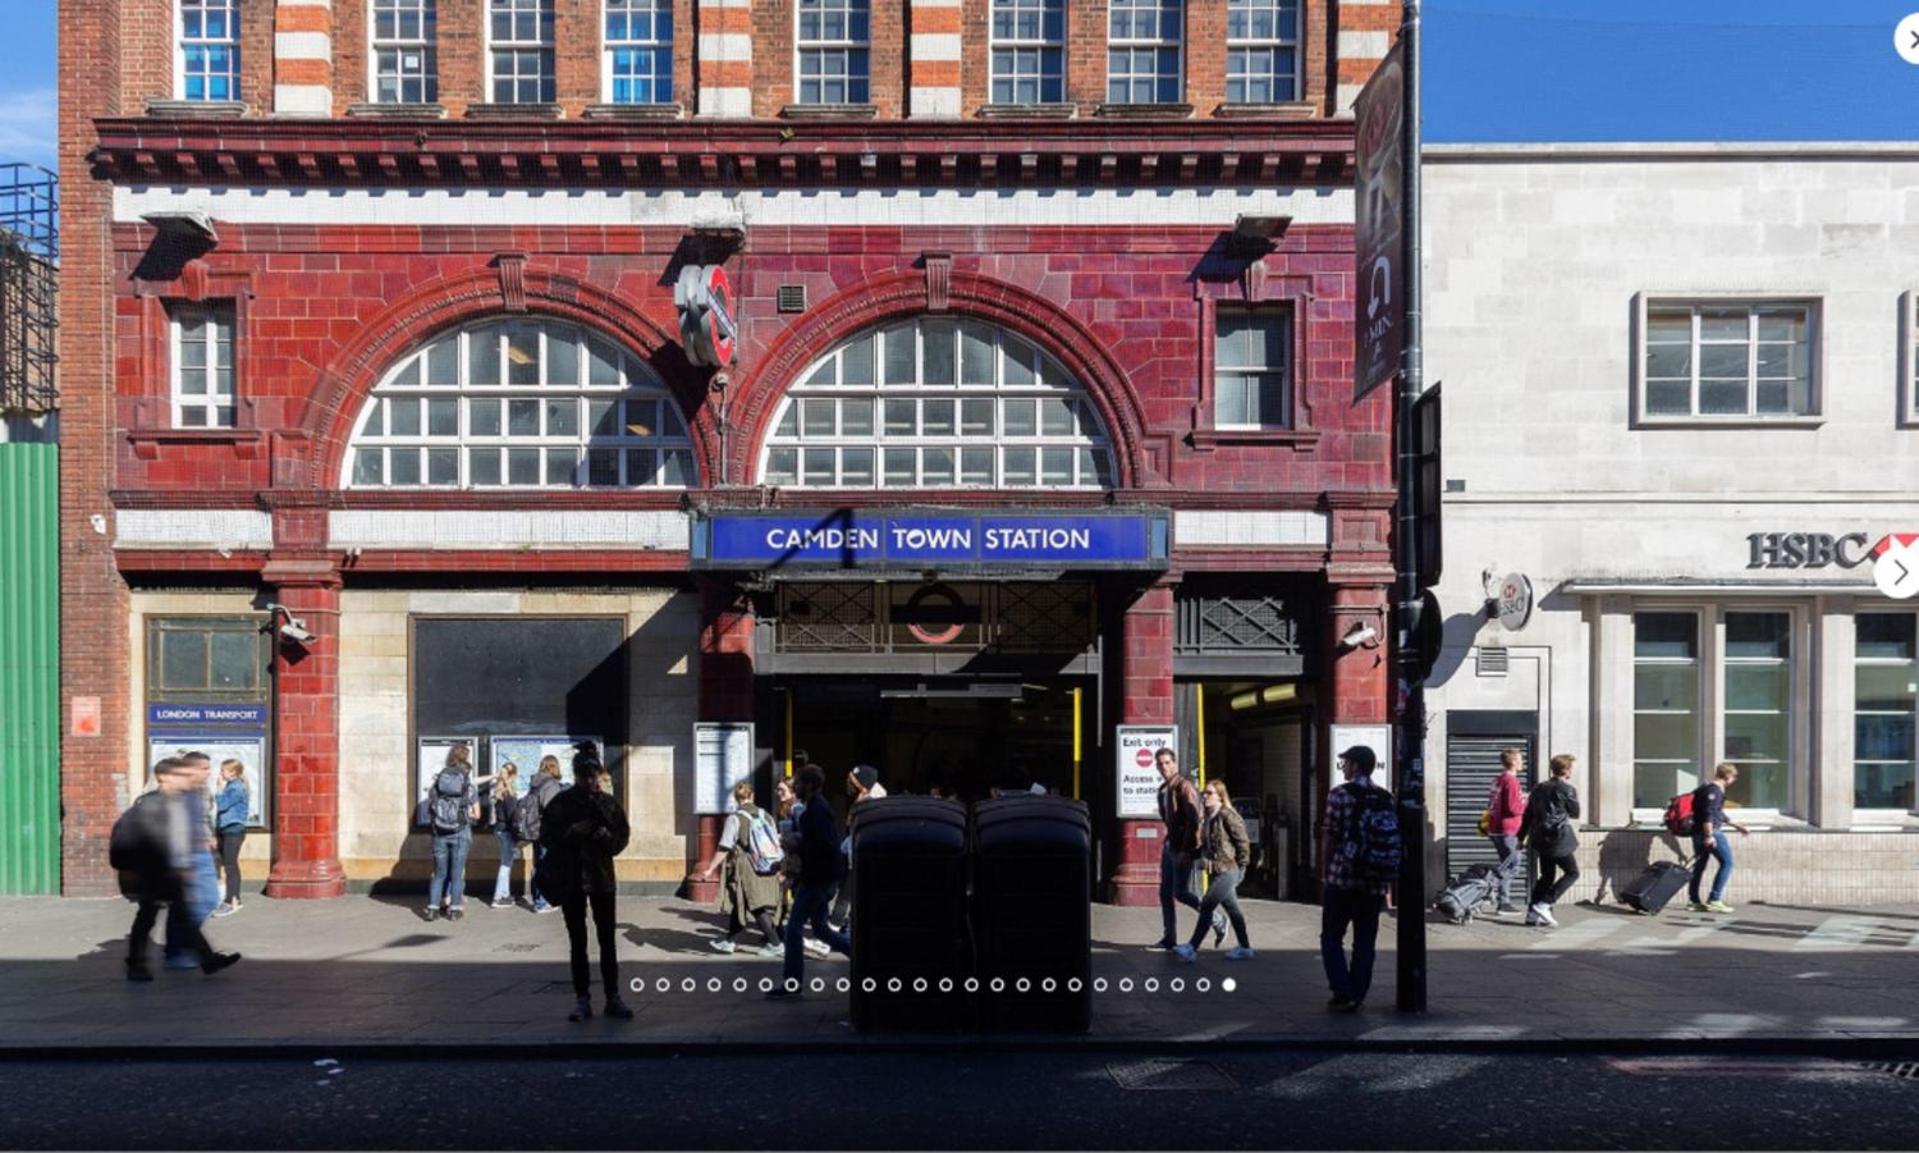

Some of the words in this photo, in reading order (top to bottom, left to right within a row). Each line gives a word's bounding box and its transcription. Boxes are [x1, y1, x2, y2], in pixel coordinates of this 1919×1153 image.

[766, 528, 878, 550] CAMDEN
[893, 528, 971, 550] TOWN
[985, 528, 1090, 550] STATION
[1746, 532, 1870, 570] HSBC
[156, 710, 200, 720] LONDON
[204, 710, 258, 720] TRANSPORT
[1123, 738, 1142, 747] Exit
[1144, 738, 1166, 748] only
[1123, 774, 1154, 783] Access
[1123, 786, 1134, 795] to
